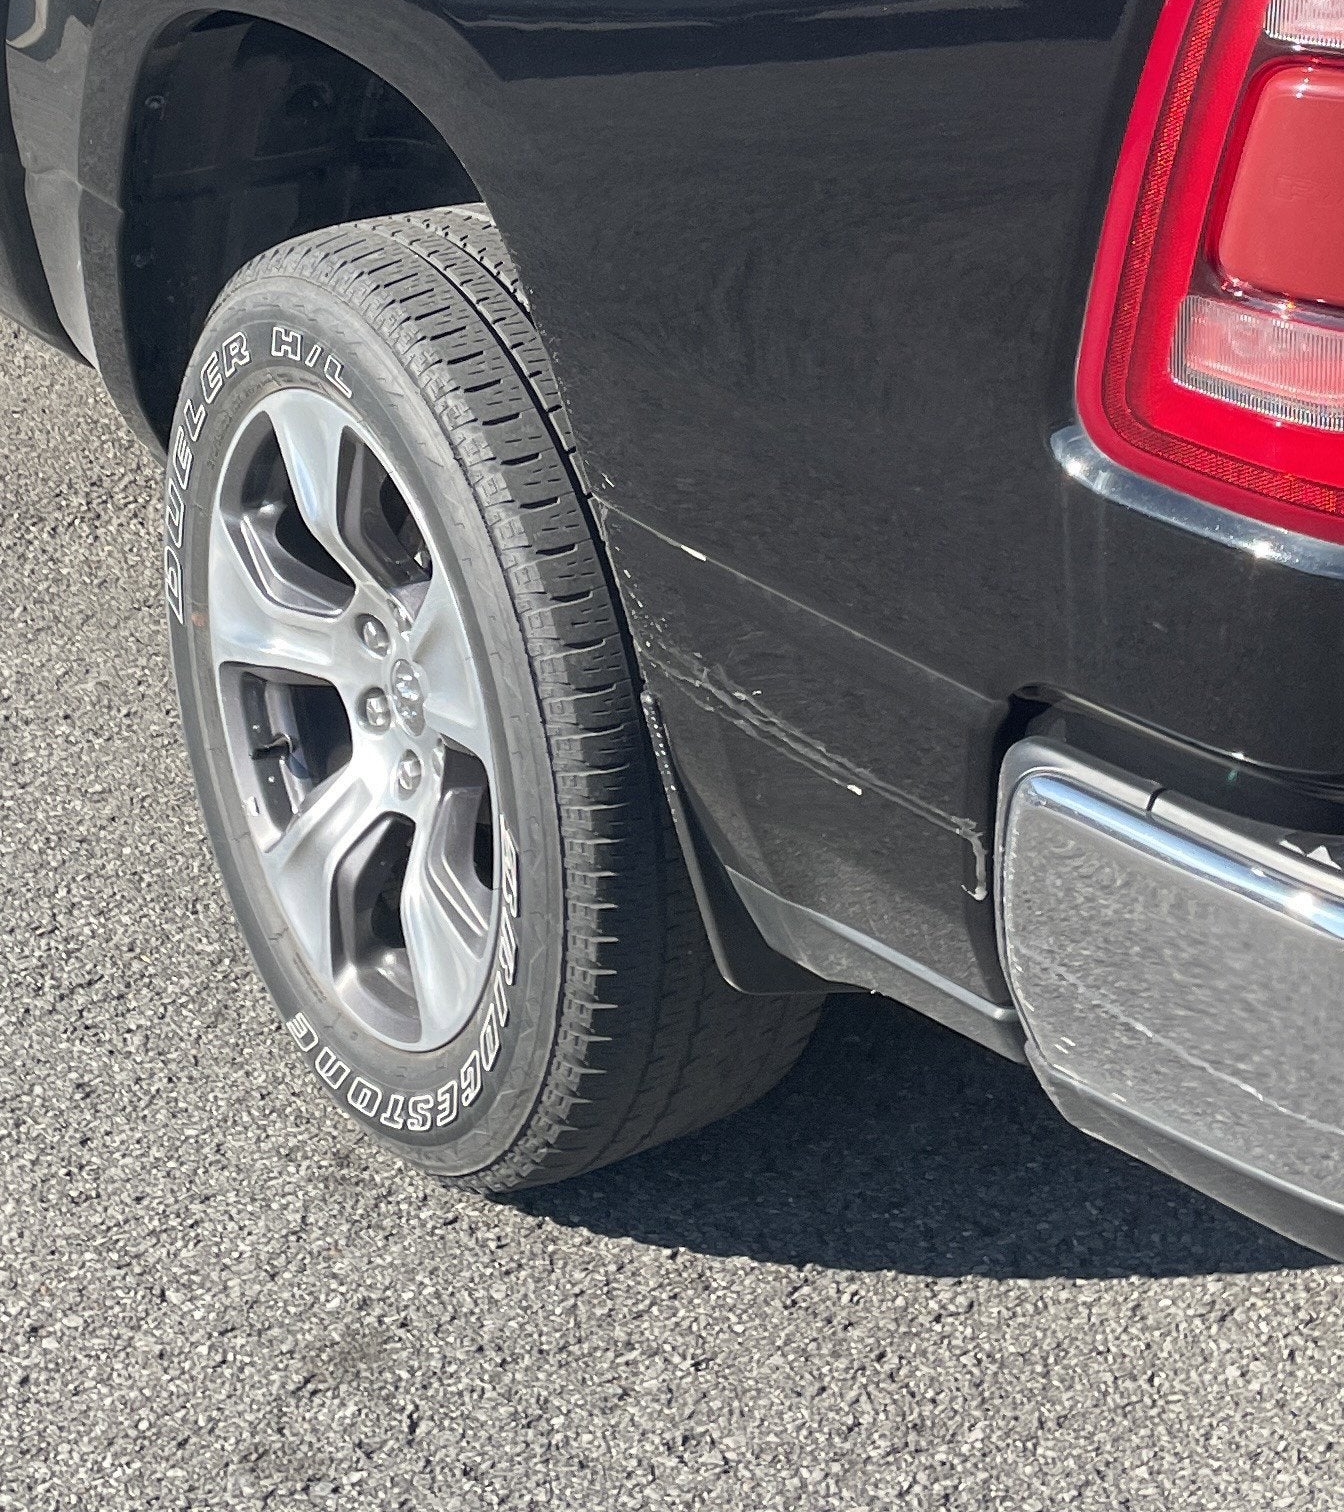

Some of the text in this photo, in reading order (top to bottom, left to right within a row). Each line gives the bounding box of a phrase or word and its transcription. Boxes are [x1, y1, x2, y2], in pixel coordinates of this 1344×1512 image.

[163, 330, 252, 626] DUELER
[270, 326, 354, 399] H/L
[285, 814, 521, 1132] BRIDGESTONE
